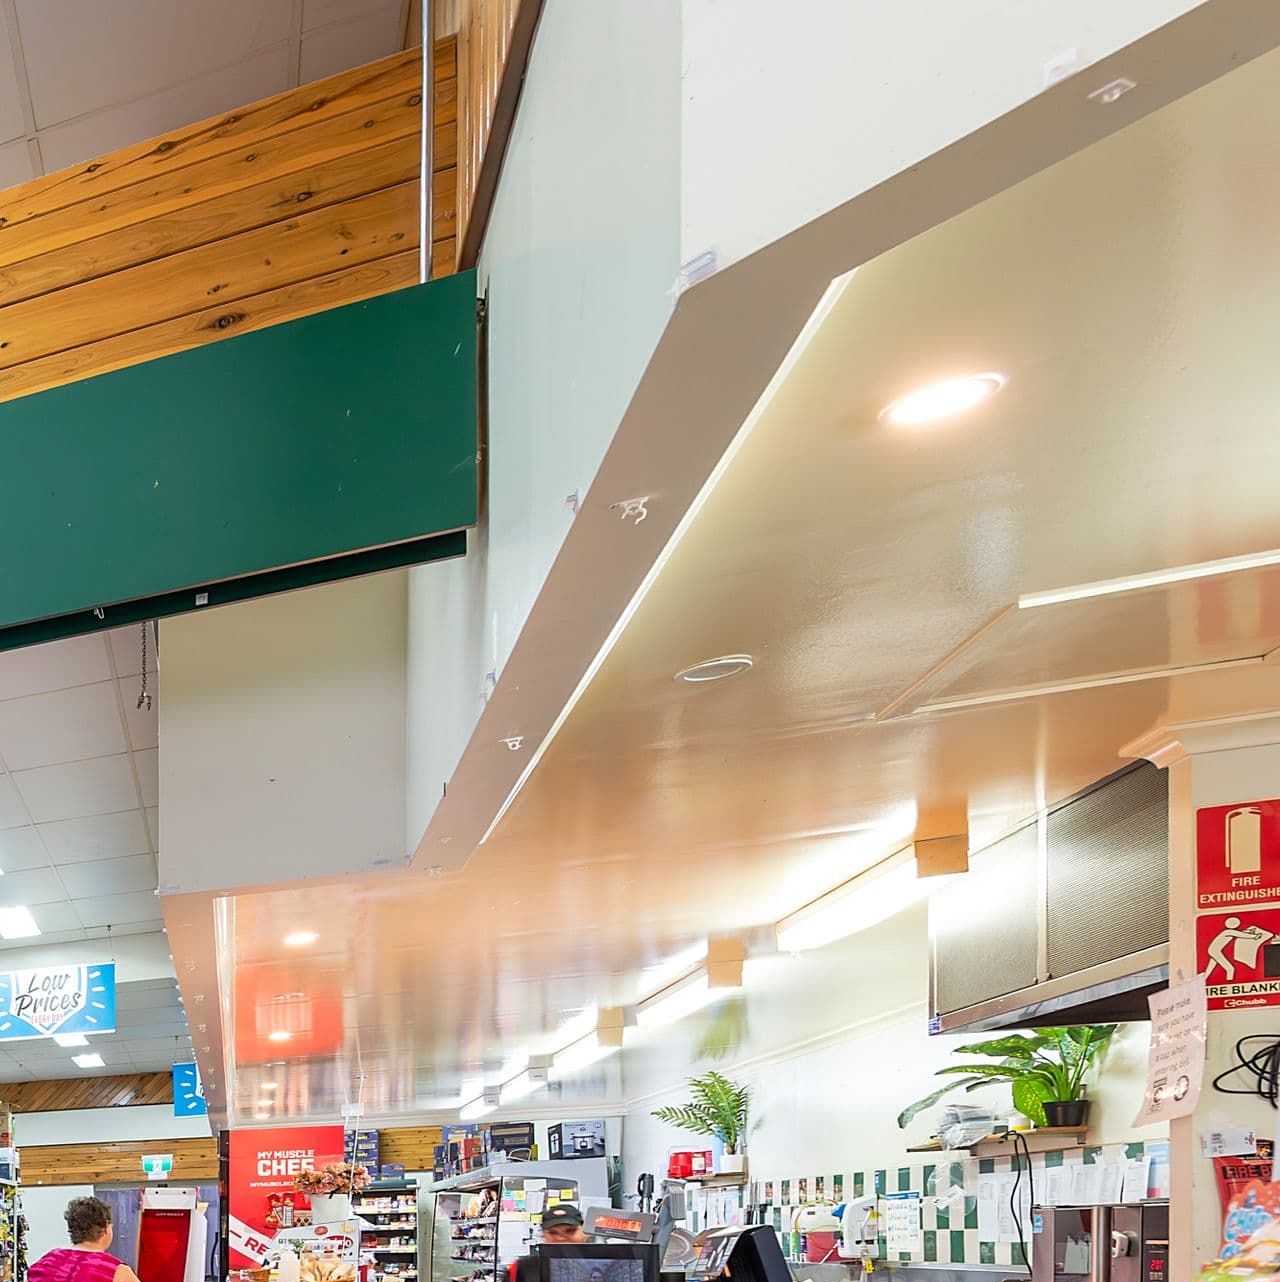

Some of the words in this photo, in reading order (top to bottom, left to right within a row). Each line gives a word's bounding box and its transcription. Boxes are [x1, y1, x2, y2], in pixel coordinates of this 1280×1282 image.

[1231, 876, 1261, 888] FIRE
[28, 972, 72, 995] Low
[1205, 986, 1228, 996] IRE
[15, 992, 82, 1017] Prices
[257, 1151, 274, 1160] MY
[276, 1149, 316, 1159] MUSCLE
